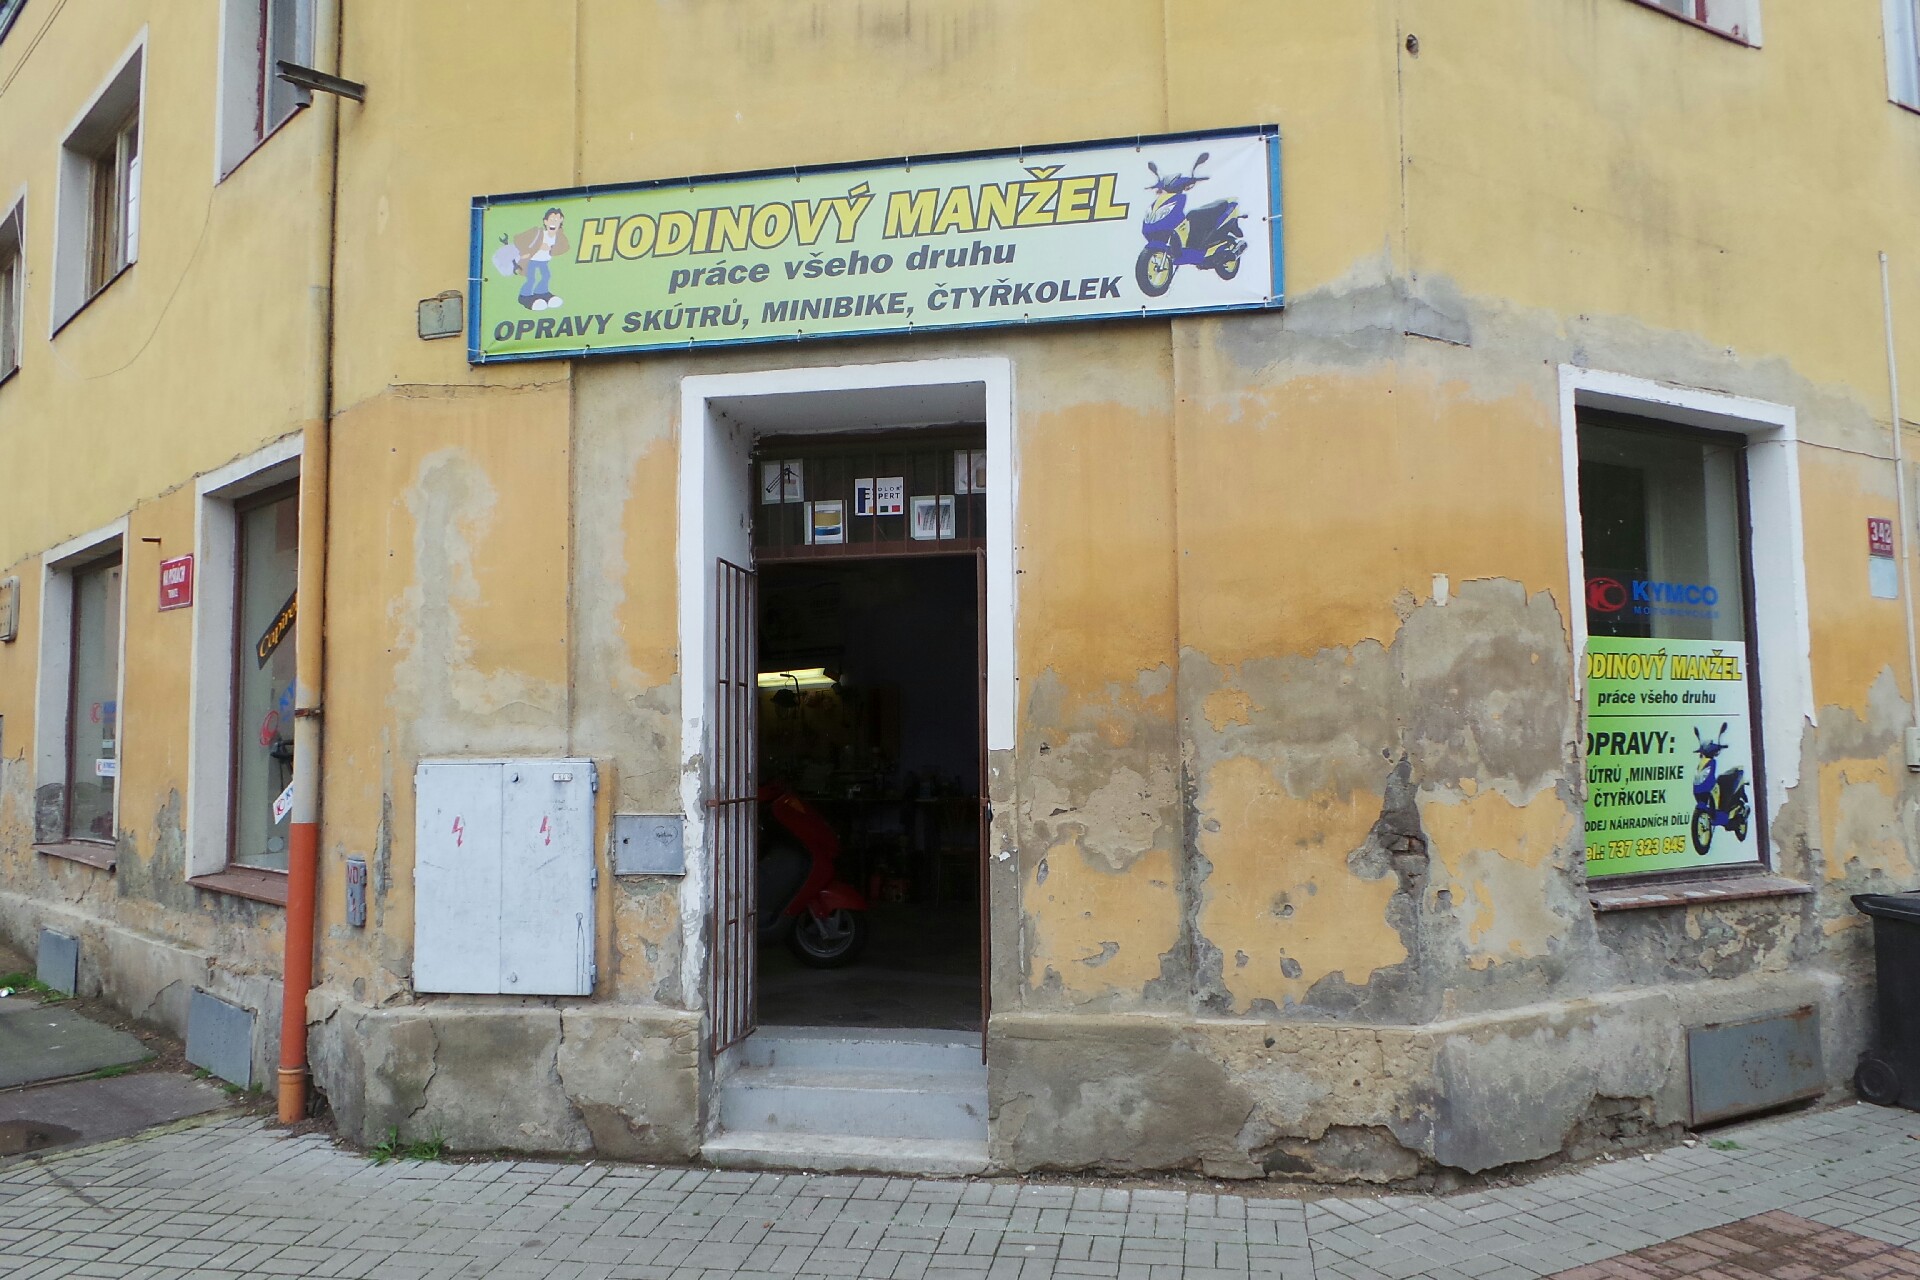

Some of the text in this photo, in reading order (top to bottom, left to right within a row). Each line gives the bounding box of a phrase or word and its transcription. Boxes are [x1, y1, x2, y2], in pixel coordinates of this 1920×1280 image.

[575, 164, 1130, 263] HODINOVÝ MANŽEL
[668, 240, 1017, 294] práce všeho druhu
[493, 276, 1123, 342] OPRAVY SKÚTRŮ, MINIBIKE, ČTYŘKOLEK
[1632, 580, 1718, 606] KYMCO
[1671, 649, 1742, 681] MANŽEL
[1598, 689, 1716, 707] práce všeho druhu
[1586, 764, 1621, 784] ÚTRŮ
[1594, 788, 1666, 808] ČTYŘKOLEK
[1609, 814, 1669, 831] NÁHRADNÍCH
[1608, 840, 1633, 859] 737
[1636, 838, 1660, 857] 323
[1663, 835, 1686, 854] 845
